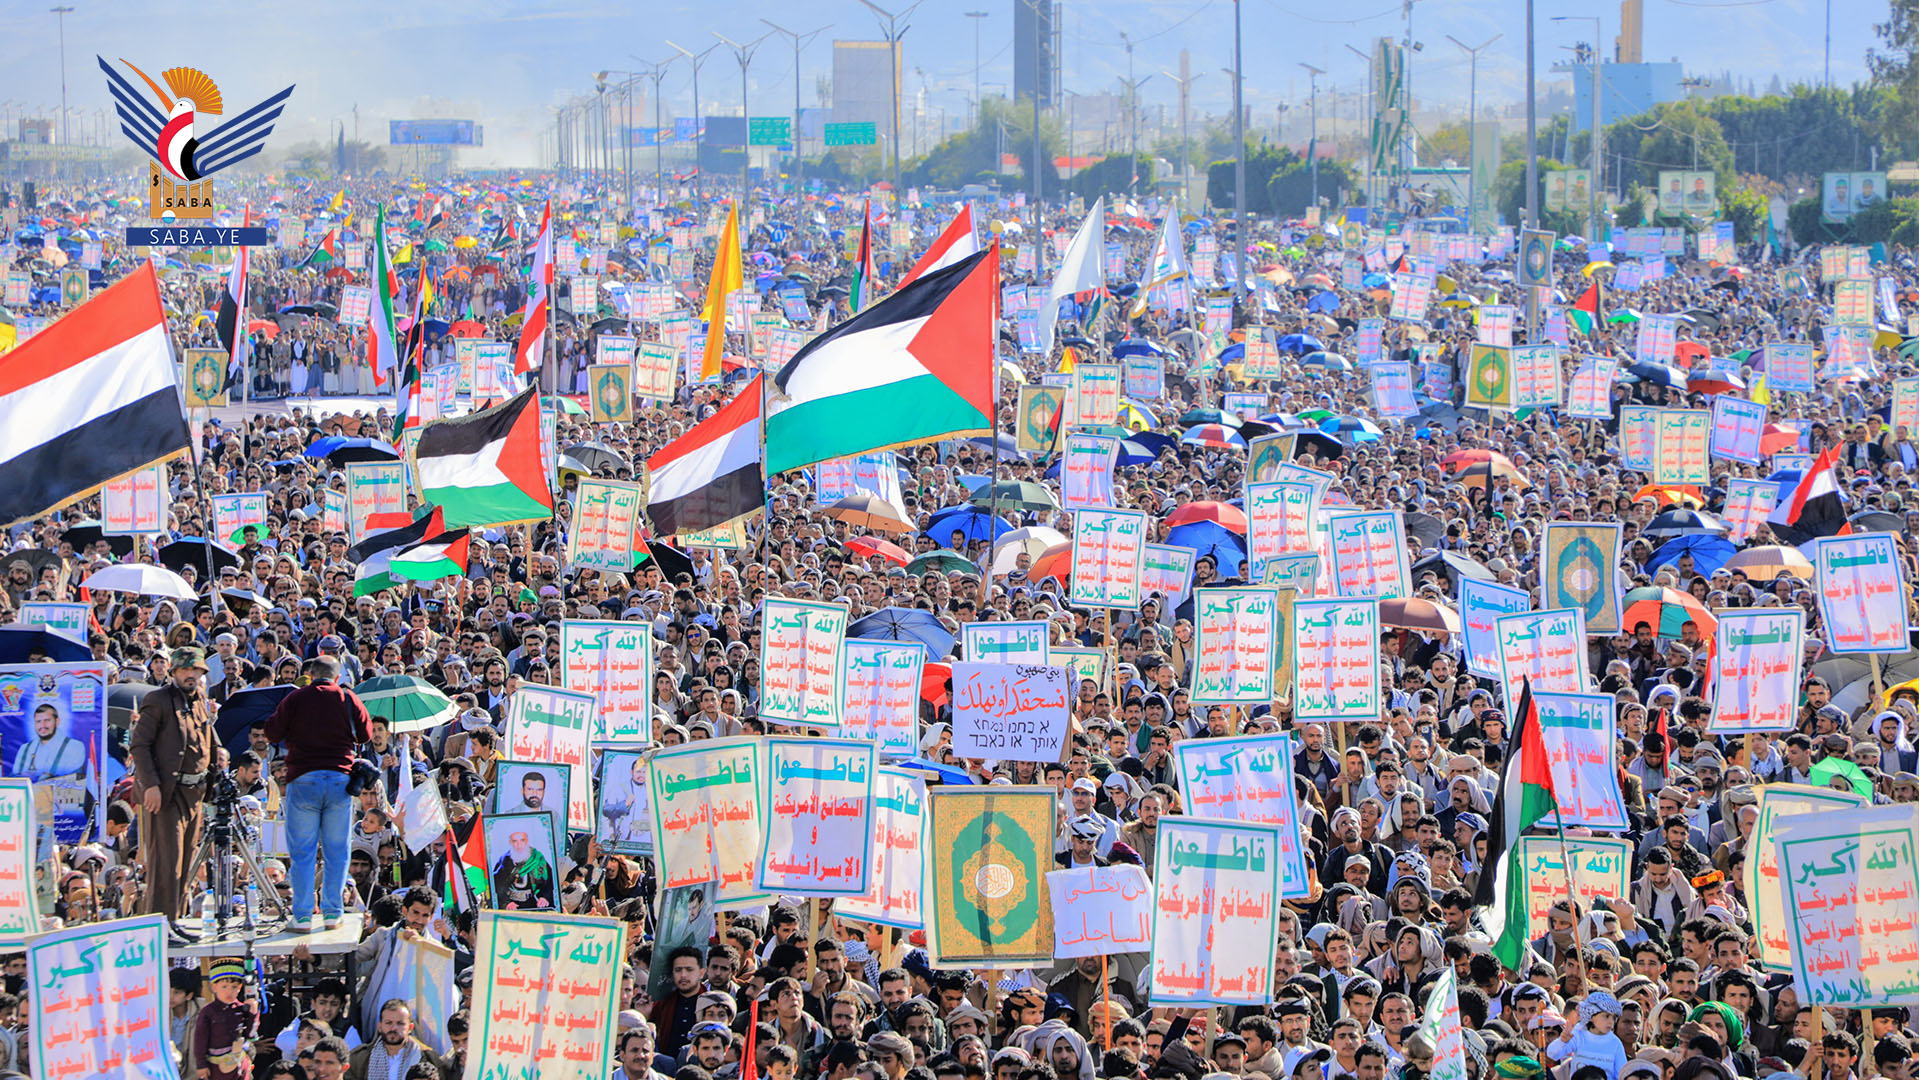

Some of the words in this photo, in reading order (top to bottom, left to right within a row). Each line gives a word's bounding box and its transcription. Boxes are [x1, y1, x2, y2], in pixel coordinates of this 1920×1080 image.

[1826, 546, 1888, 573] قاطعوا
[1824, 578, 1862, 602] الأمريكية
[1865, 576, 1897, 598] البضائع
[1203, 596, 1244, 618] أكبر
[1246, 598, 1274, 615] الله
[1344, 608, 1371, 626] الله
[1861, 601, 1866, 617] و
[769, 612, 813, 633] أكبر
[814, 615, 840, 633] الله
[1202, 619, 1237, 634] لأمريكا
[1240, 622, 1269, 636] الموت
[1299, 605, 1342, 633] أكبر
[570, 629, 614, 655] أكبر
[616, 632, 643, 650] الله
[768, 635, 806, 651] لأمريكا
[974, 630, 1039, 659] قاطعوا
[1299, 634, 1336, 649] لأمريكا
[1340, 634, 1371, 648] الموت
[1726, 620, 1791, 652] قاطعوا
[1835, 623, 1903, 645] الإسرائيلية
[808, 640, 835, 656] الموت
[569, 656, 608, 673] لأمريكا
[611, 659, 643, 673] الموت
[766, 656, 806, 672] لإسرائيل
[808, 663, 833, 676] الموت
[849, 650, 891, 671] أكبر
[892, 652, 918, 669] الله
[1299, 656, 1337, 671] لإسرائيل
[1340, 656, 1372, 669] الموت
[1721, 656, 1759, 681] الأمريكية
[1762, 656, 1794, 679] البضائع
[611, 679, 643, 694] الموت
[766, 677, 792, 691] اليهود
[848, 674, 884, 688] لأمريكا
[886, 677, 915, 690] الموت
[1046, 669, 1059, 682] بني
[1198, 677, 1232, 695] للإسلام
[1235, 677, 1267, 696] النصر
[1299, 676, 1326, 691] اليهود
[1329, 677, 1344, 690] على
[1349, 676, 1372, 687] اللعنة
[796, 682, 809, 693] على
[812, 683, 832, 696] اللعنة
[1752, 680, 1758, 697] و
[520, 696, 585, 729] قاطعوا
[619, 699, 643, 712] اللعنة
[765, 693, 801, 717] للإسلام
[802, 695, 833, 718] النصر
[1300, 695, 1336, 712] للإسلام
[1340, 693, 1372, 712] النصر
[1540, 703, 1603, 733] قاطعو
[1717, 704, 1791, 725] الإسرائيلية
[611, 717, 643, 738] النصر
[513, 733, 549, 759] الأمريكية
[881, 730, 912, 749] النصر
[1011, 736, 1022, 748] או
[775, 755, 865, 786] قاطعوا
[1192, 746, 1244, 784] أكبر
[1249, 748, 1283, 773] الله
[658, 757, 751, 801] قاطعوا
[1192, 784, 1242, 806] لأمريكا
[1246, 783, 1285, 803] الموت
[712, 800, 754, 827] البضائع
[774, 792, 819, 818] الأمريكية
[820, 798, 863, 819] البضائع
[664, 806, 710, 835] الأمريكية
[706, 833, 712, 854] و
[811, 825, 817, 845] و
[1169, 832, 1265, 875] قاطعوا
[1795, 841, 1859, 887] أكبر
[1867, 842, 1908, 870] الله
[768, 852, 860, 882] الإسرائيلية
[1122, 870, 1147, 901] لن
[1864, 880, 1913, 905] الموت
[1158, 883, 1215, 920] الأمريكية
[1219, 890, 1270, 925] البضائع
[1798, 882, 1858, 912] لأمريكا
[1062, 912, 1151, 944] الساحات
[1804, 917, 1864, 945] لإسرائيل
[1869, 912, 1917, 937] الموت
[498, 927, 569, 964] أكبر
[1206, 924, 1214, 952] و
[115, 938, 155, 968] الله
[570, 935, 612, 964] الله
[1857, 947, 1880, 972] على
[43, 941, 109, 989] أكبر
[1808, 950, 1850, 976] اليهود
[110, 976, 155, 1004] الموت
[496, 967, 555, 993] لأمريكا
[559, 978, 608, 999] الموت
[1156, 960, 1266, 1000] الإسرائيلية
[1815, 977, 1872, 1005] للإسلام
[44, 987, 104, 1013] لأمريكا
[113, 1008, 156, 1038] الموت
[493, 1000, 550, 1030] لإسرائيل
[555, 1010, 603, 1032] الموت
[46, 1017, 108, 1049] لإسرائيل
[128, 1040, 158, 1064] اللعنة
[489, 1034, 531, 1058] اليهود
[534, 1041, 557, 1062] على
[563, 1040, 600, 1062] اللعنة
[48, 1051, 93, 1079] اليهود
[99, 1049, 122, 1073] على
